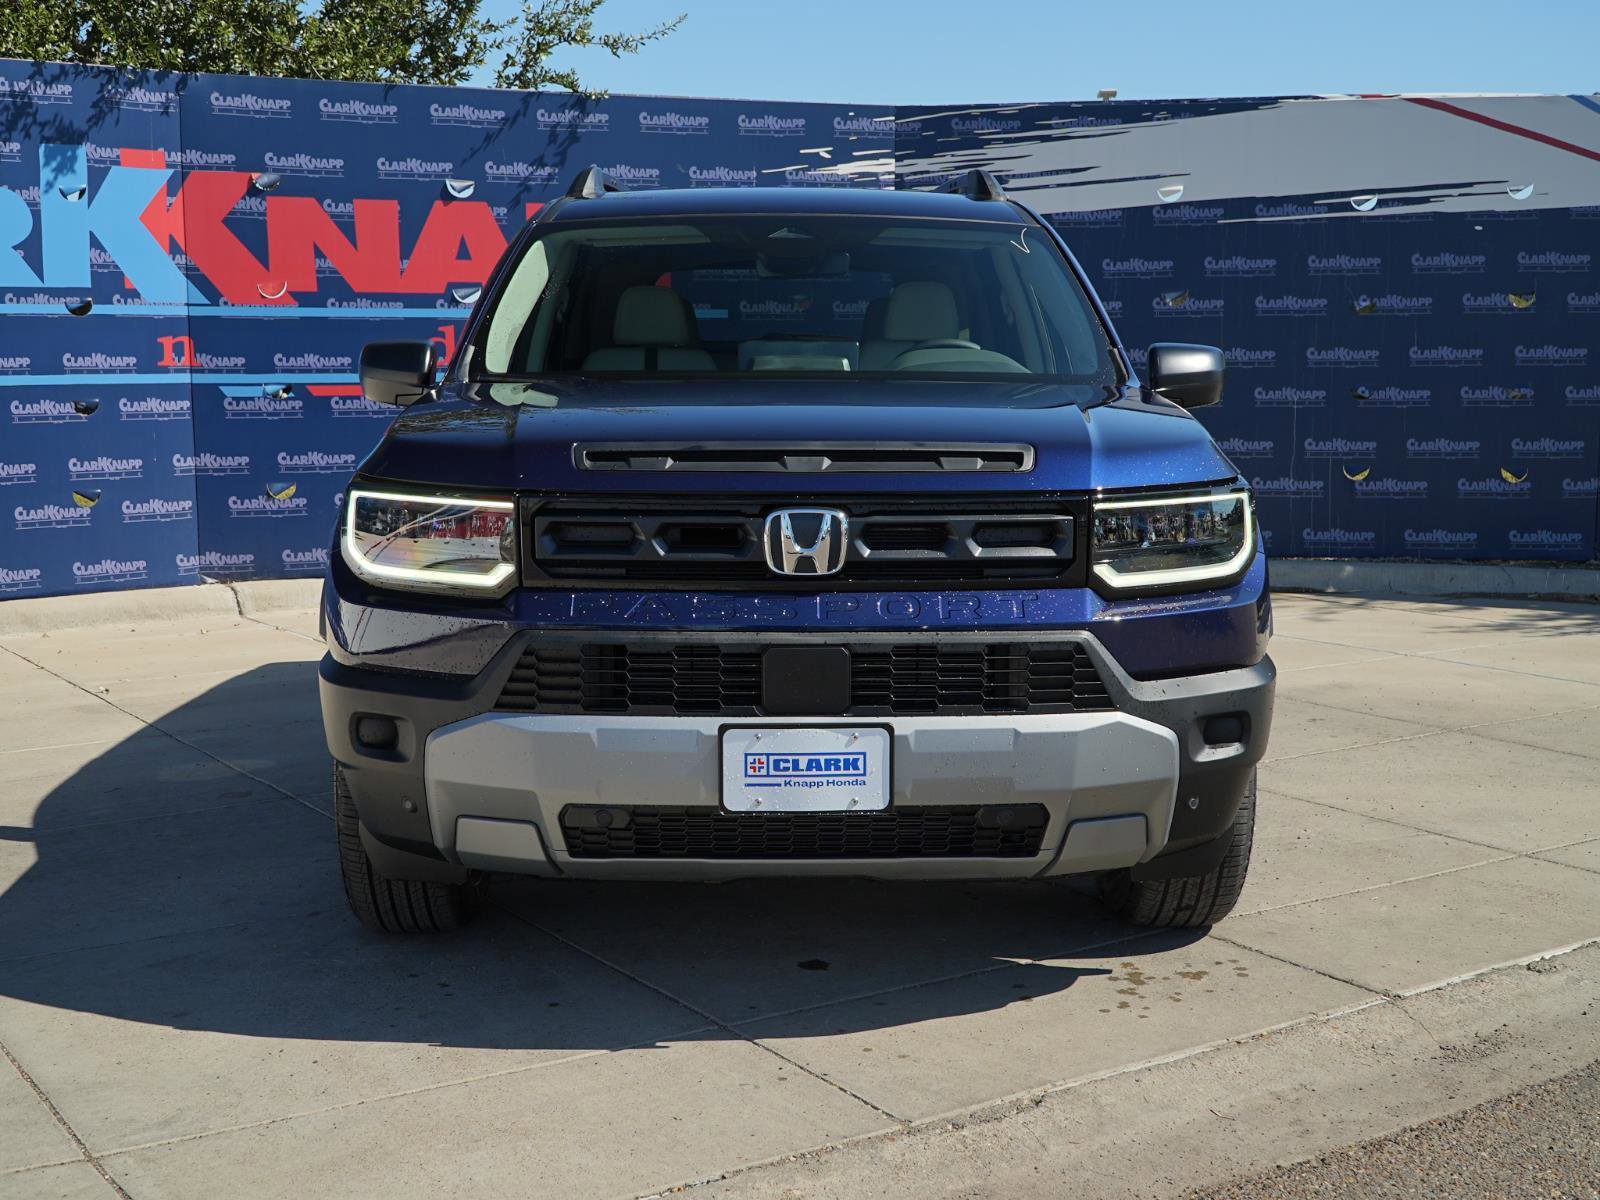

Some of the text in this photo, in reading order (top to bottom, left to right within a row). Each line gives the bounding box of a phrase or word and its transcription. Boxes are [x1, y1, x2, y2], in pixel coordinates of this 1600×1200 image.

[569, 591, 1039, 622] PASSPORT
[772, 757, 861, 773] CLARK
[784, 778, 866, 789] Knapp Honda
